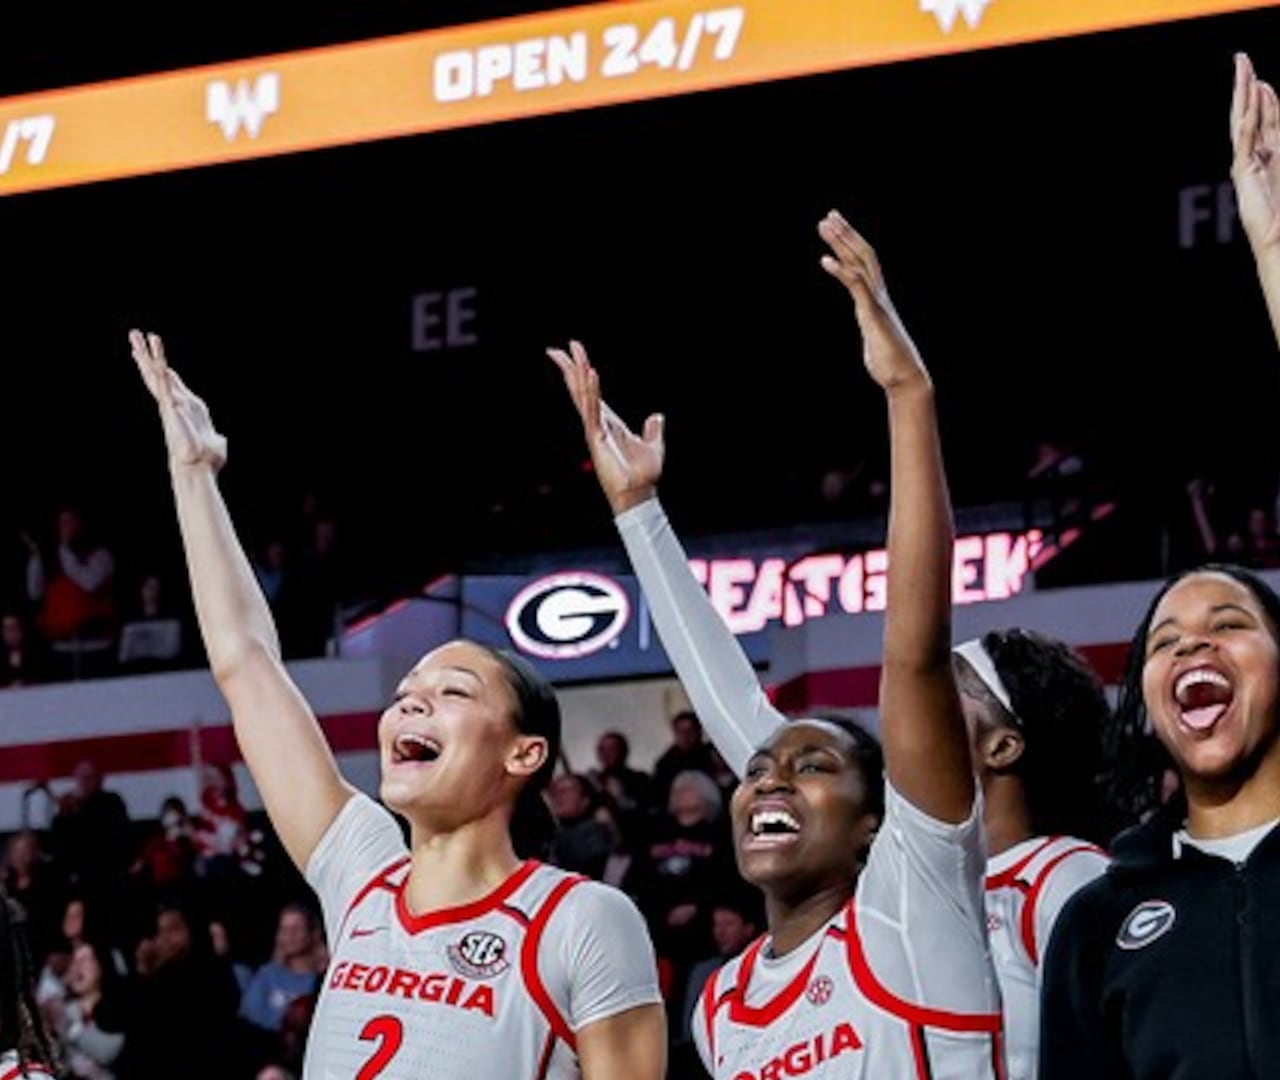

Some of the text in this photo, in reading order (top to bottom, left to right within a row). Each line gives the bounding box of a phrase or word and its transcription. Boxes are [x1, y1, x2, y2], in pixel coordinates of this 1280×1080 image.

[433, 8, 744, 102] OPEN 24/7
[410, 286, 480, 352] EE
[460, 932, 506, 967] SEC
[330, 960, 495, 1018] GEORGIA
